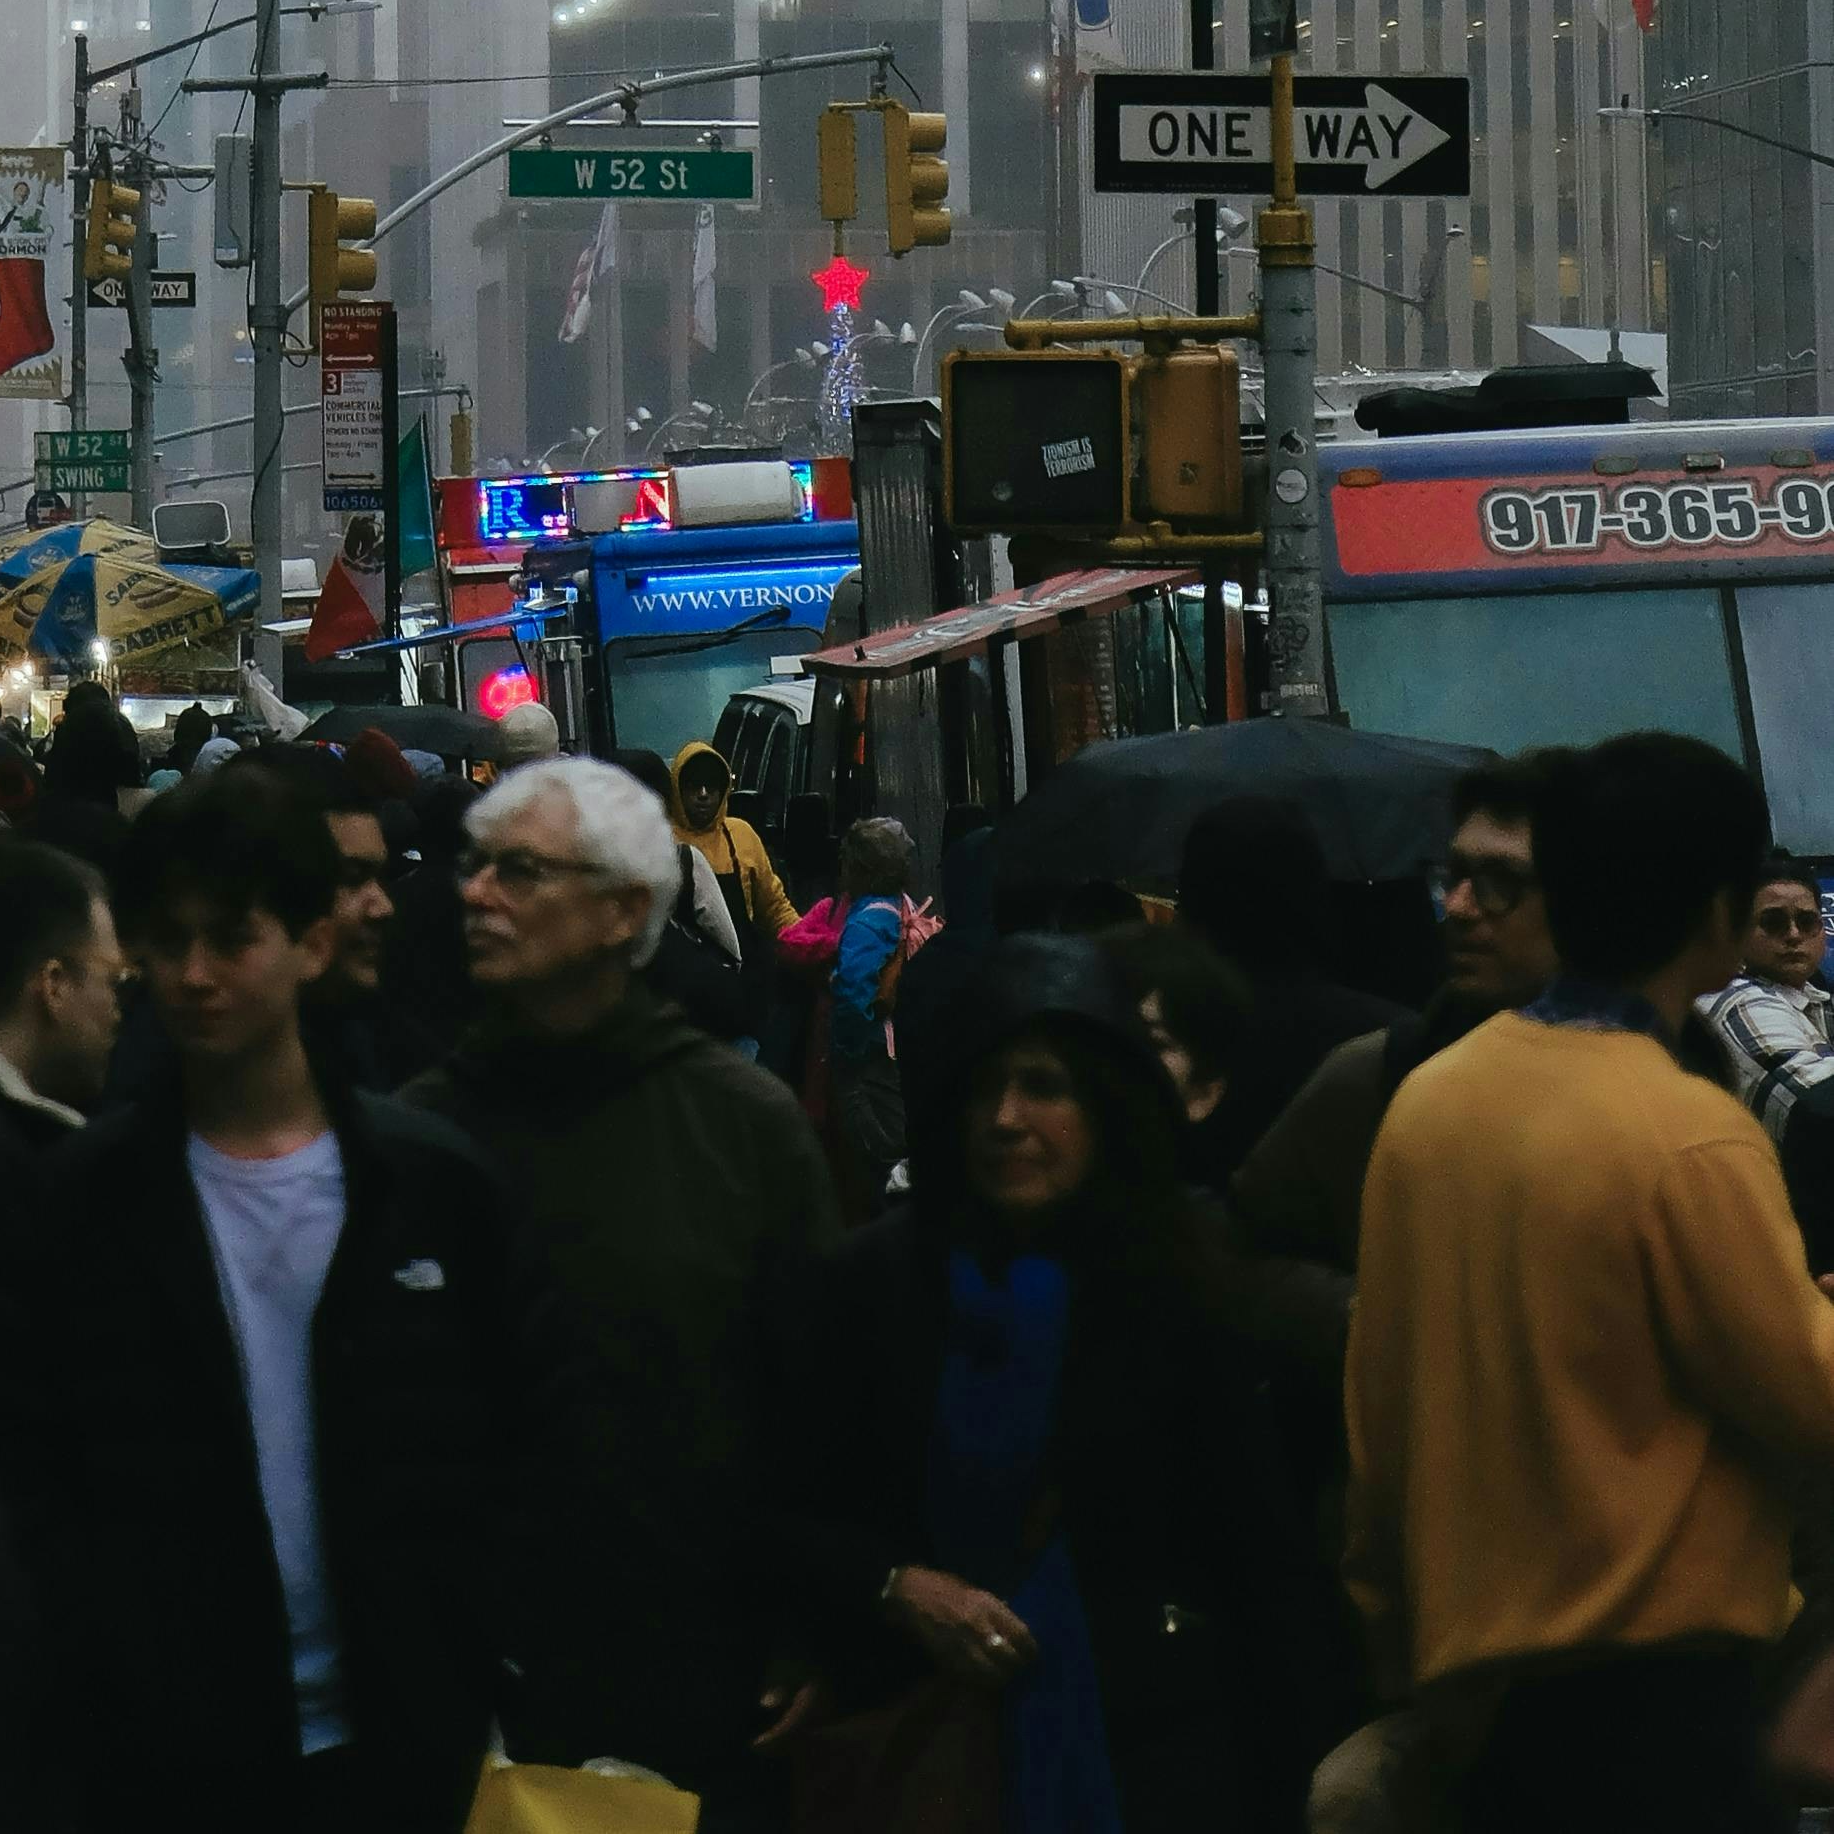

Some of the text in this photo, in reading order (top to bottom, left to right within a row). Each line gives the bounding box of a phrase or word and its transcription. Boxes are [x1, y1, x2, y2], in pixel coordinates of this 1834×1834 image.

[1148, 110, 1413, 159] ONE WAY
[574, 157, 690, 192] W 52 St
[103, 283, 125, 297] ON
[324, 307, 383, 317] NO STANDING
[326, 400, 382, 412] COMMERCIAL
[326, 412, 382, 423] VEHICLES ON
[55, 437, 71, 457] W
[77, 435, 104, 457] 52
[55, 467, 105, 489] SWING
[325, 495, 383, 509] 106506
[1485, 480, 1834, 551] 917-365-9
